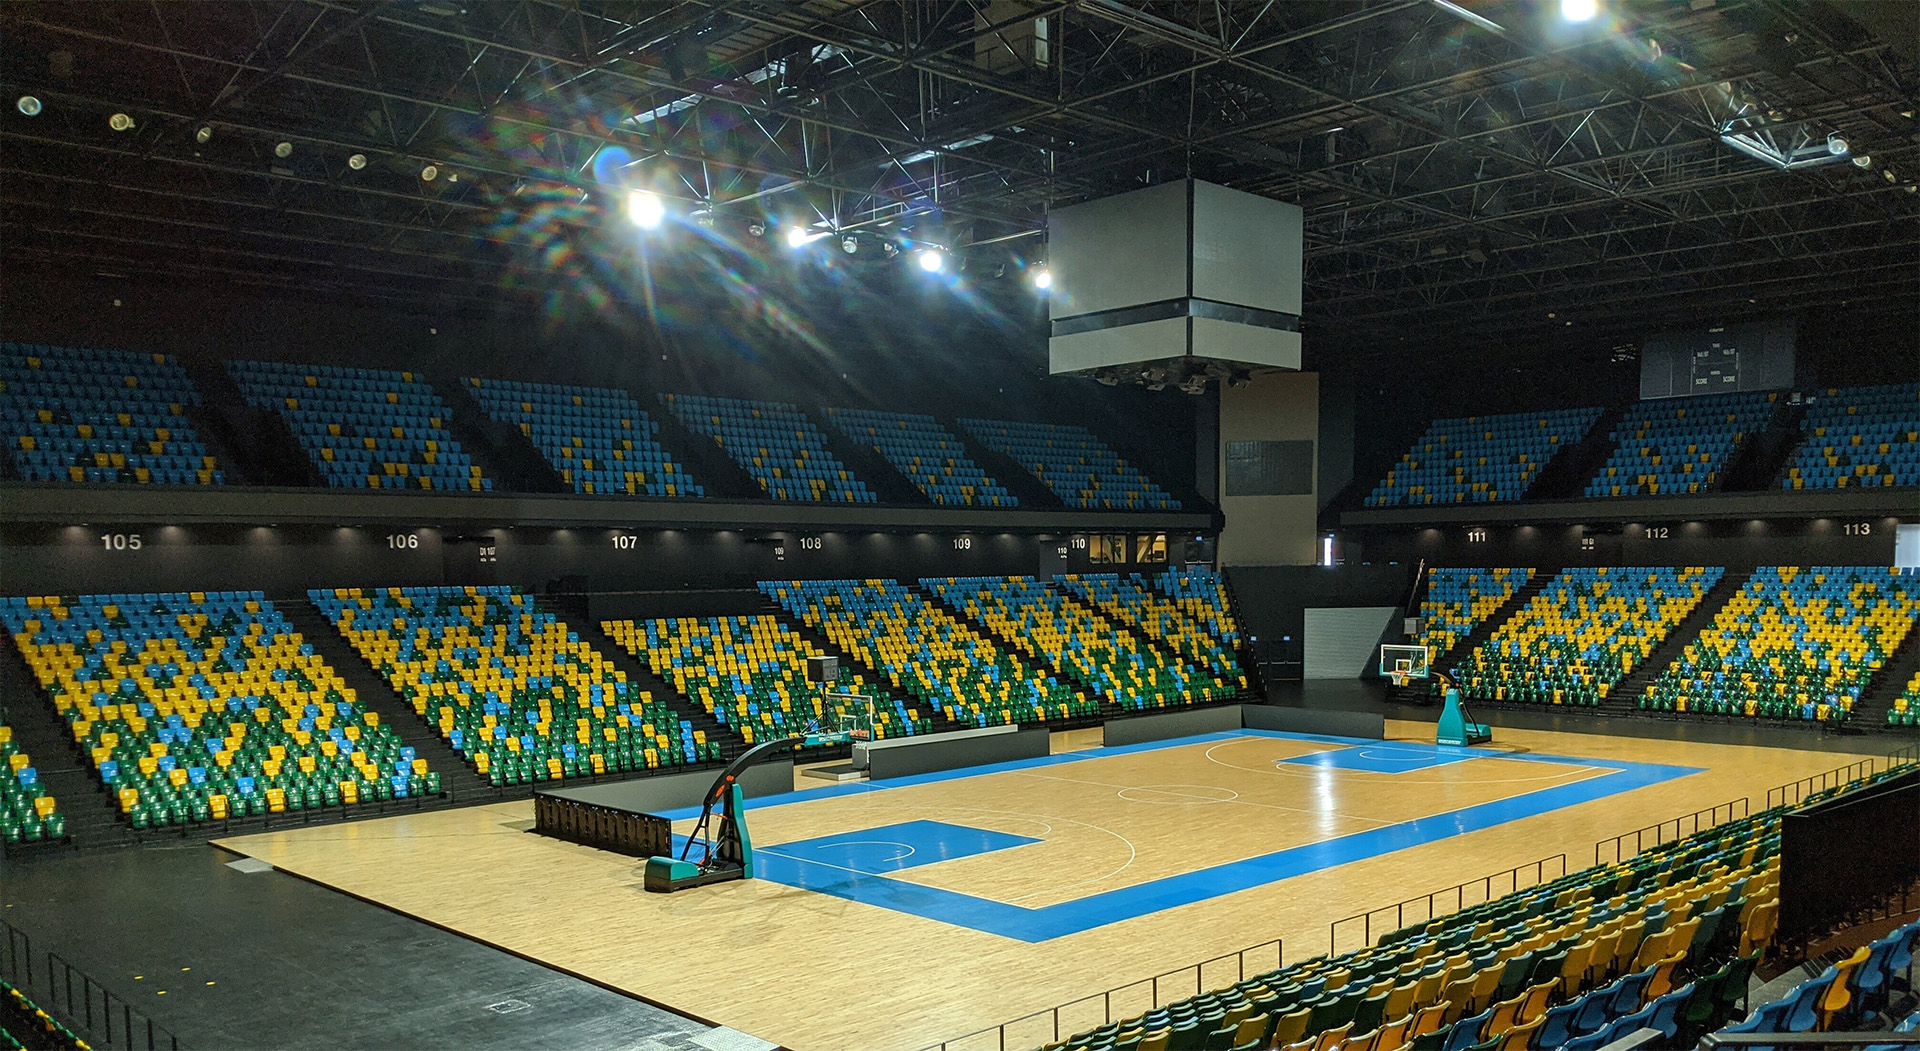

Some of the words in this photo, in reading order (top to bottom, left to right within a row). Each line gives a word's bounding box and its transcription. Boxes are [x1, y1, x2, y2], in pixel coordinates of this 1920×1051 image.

[1645, 527, 1668, 539] 112
[1843, 523, 1869, 535] 113
[101, 533, 142, 550] 105
[386, 534, 418, 549] 106
[611, 535, 637, 549] 107
[1467, 531, 1486, 542] 111
[800, 537, 822, 550] 108
[953, 538, 971, 550] 109
[1070, 538, 1086, 549] 110
